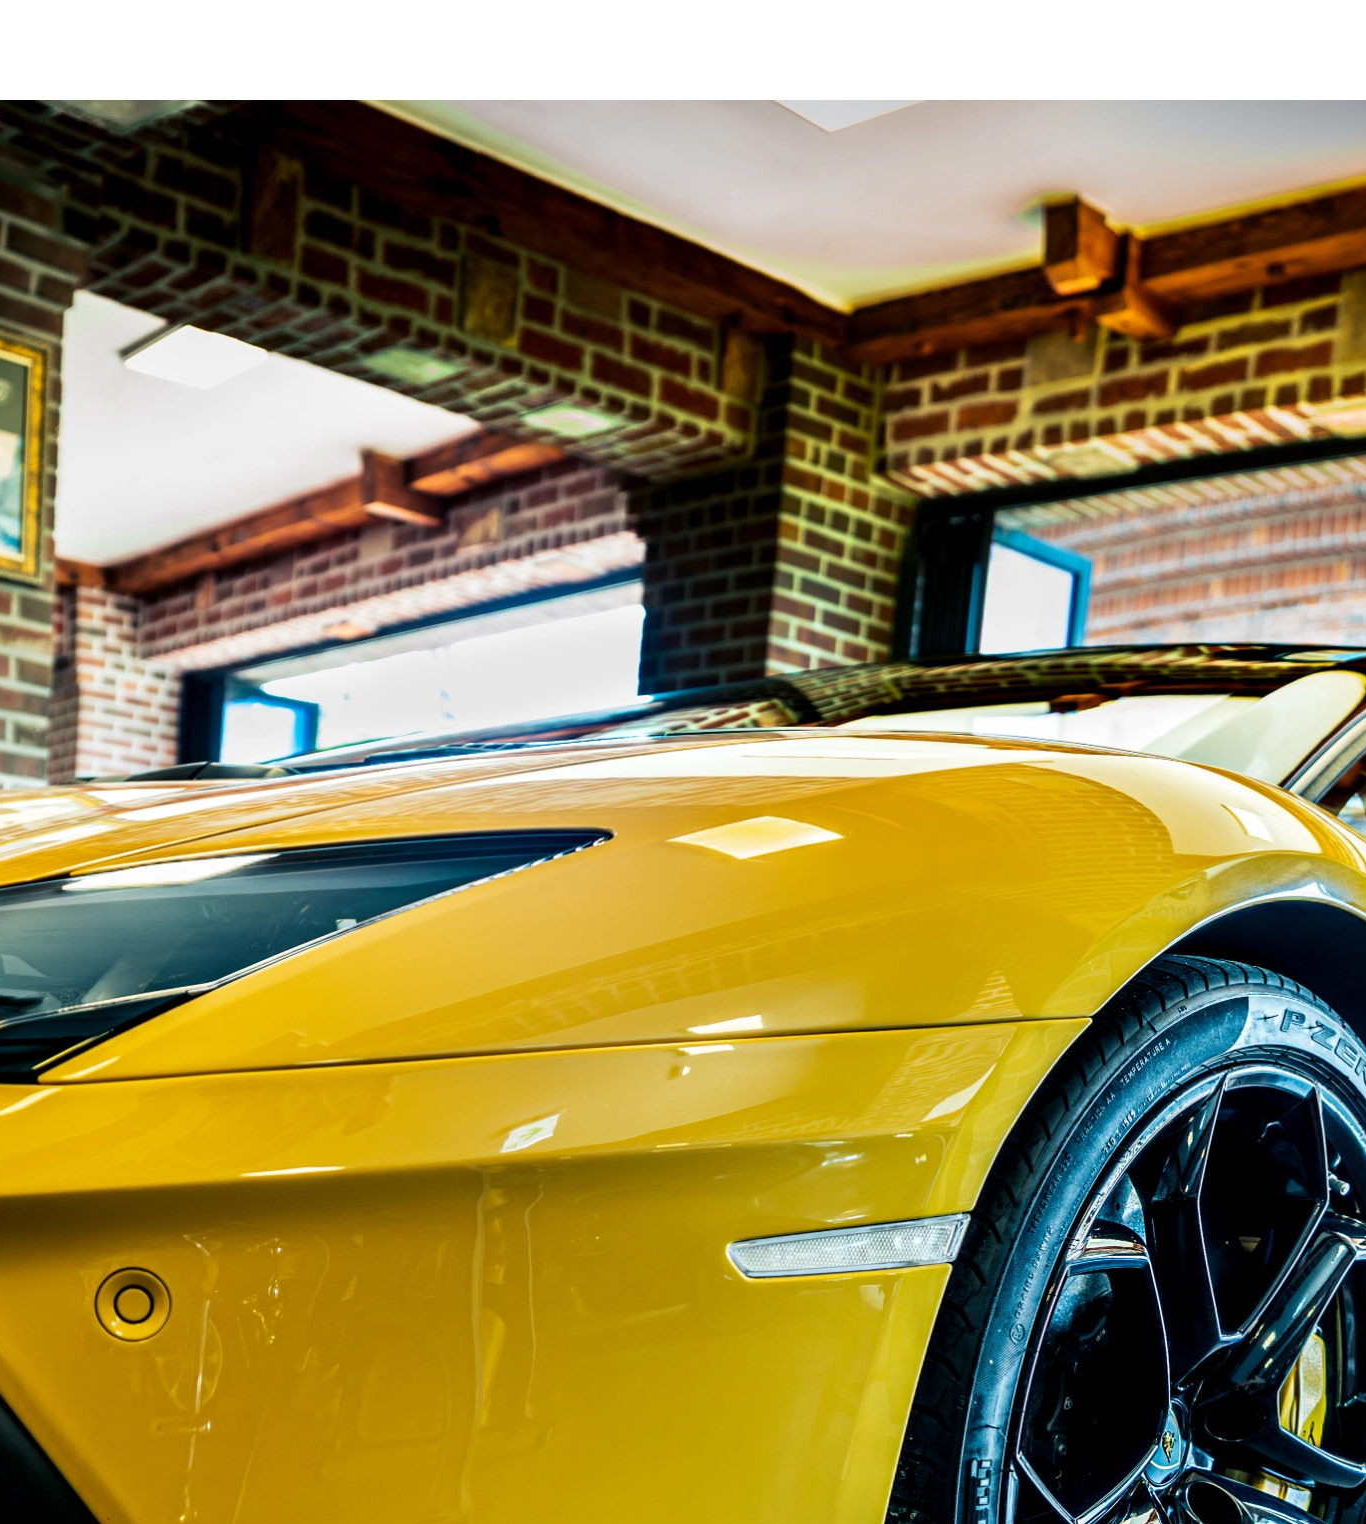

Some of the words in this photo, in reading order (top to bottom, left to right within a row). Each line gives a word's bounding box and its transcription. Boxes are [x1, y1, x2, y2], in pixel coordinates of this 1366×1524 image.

[1119, 1041, 1165, 1088] TEMPERATURE
[1165, 1038, 1171, 1047] A
[1075, 1105, 1106, 1146] TRACTION
[1105, 1092, 1116, 1107] AA
